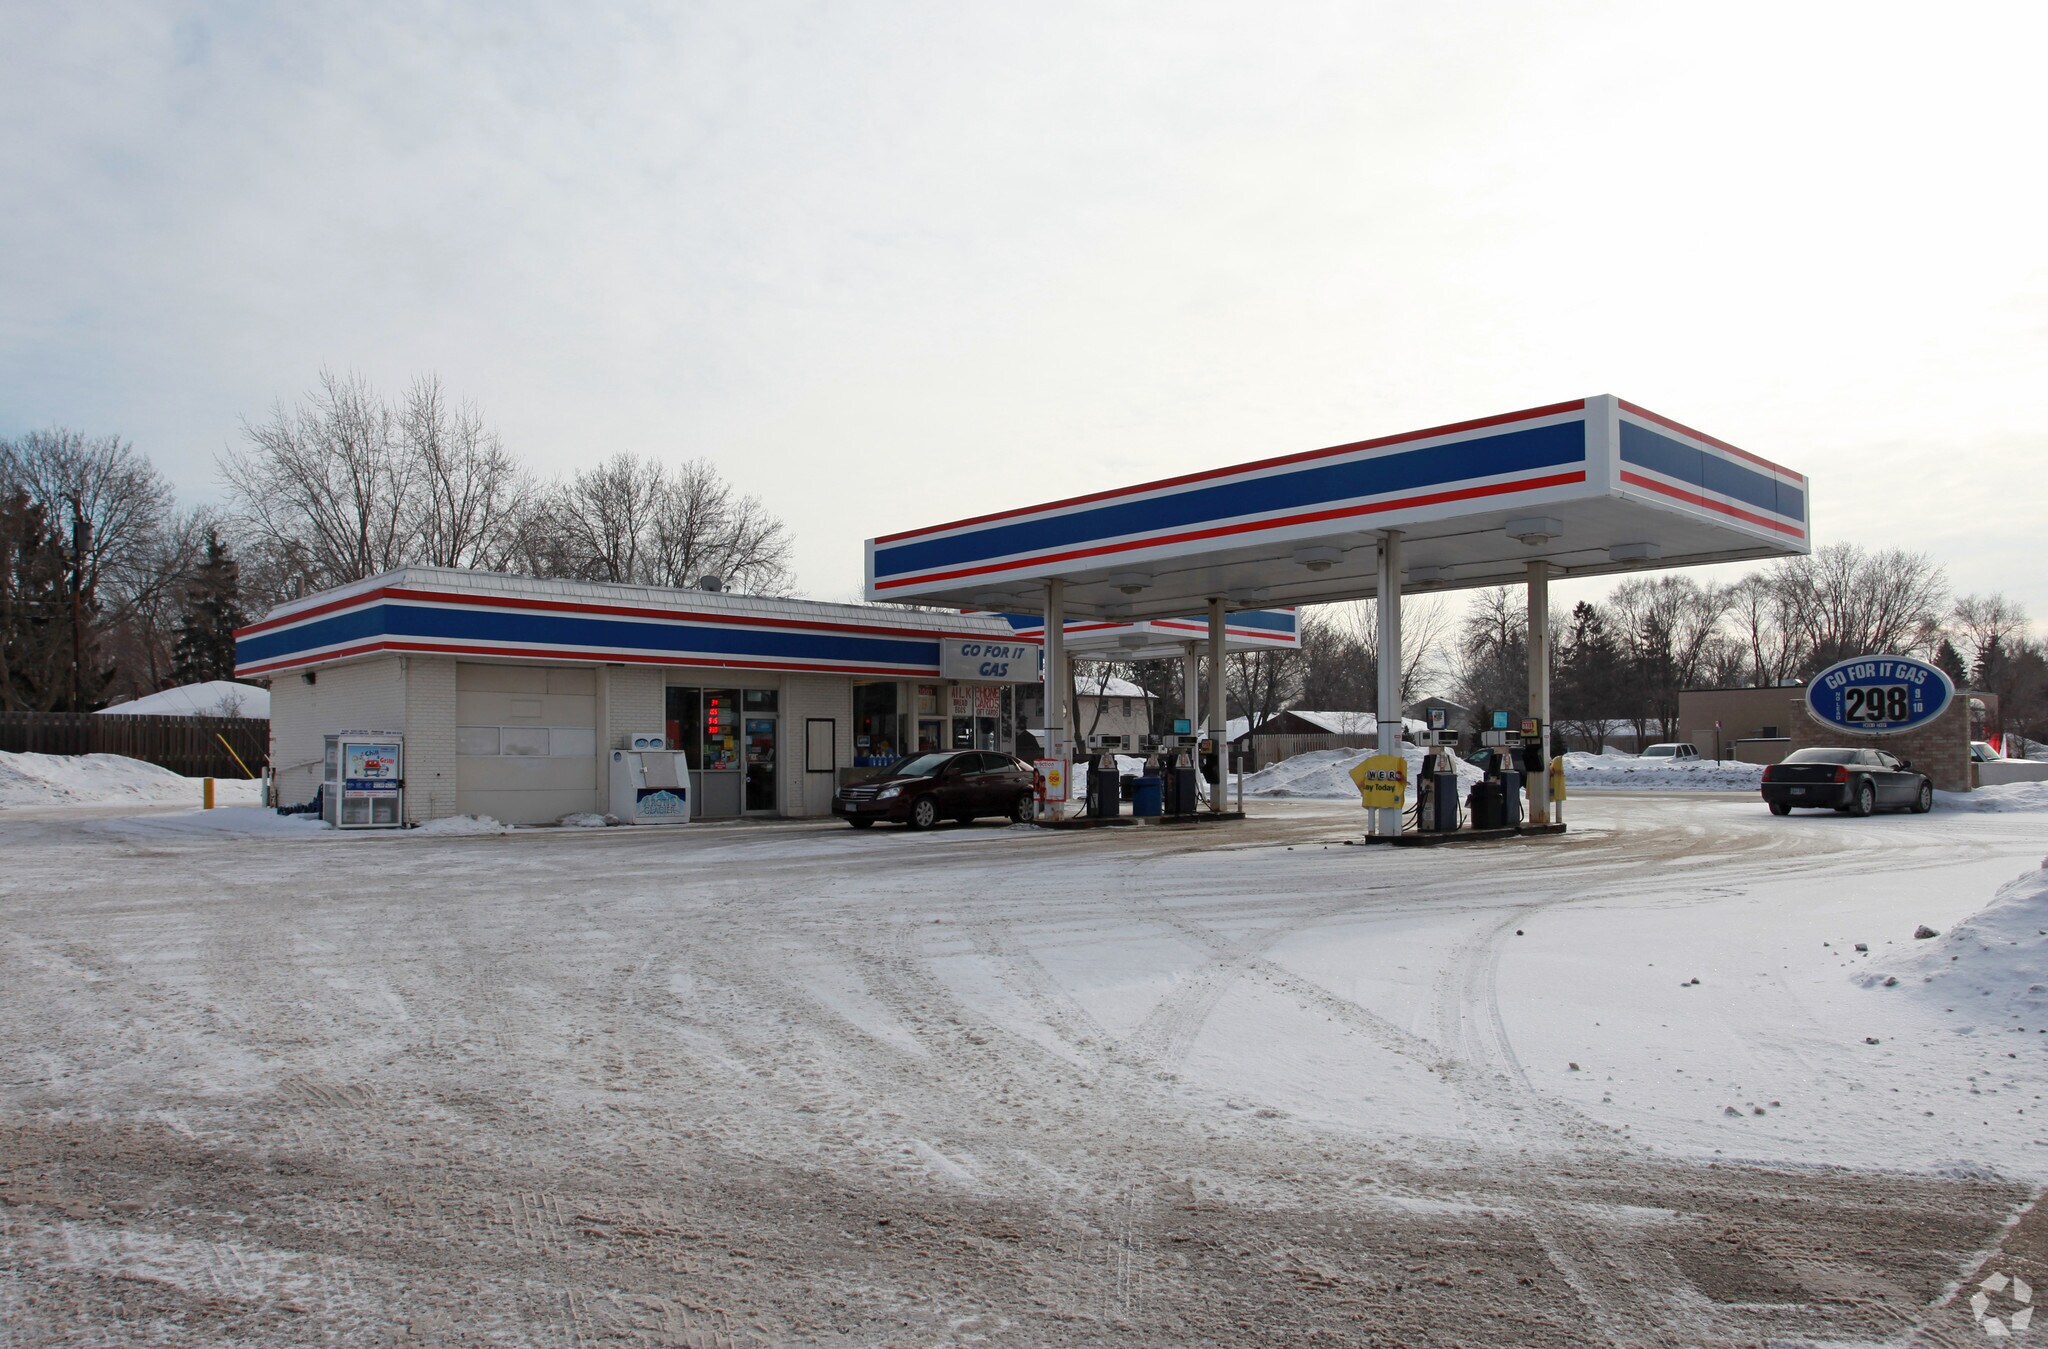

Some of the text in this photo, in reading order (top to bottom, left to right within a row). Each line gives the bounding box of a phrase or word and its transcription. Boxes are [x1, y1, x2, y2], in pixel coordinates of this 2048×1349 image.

[961, 644, 1026, 660] GO FOR IT
[979, 661, 1009, 677] GAS
[1825, 662, 1928, 690] GO FOR IT GAS
[975, 686, 1000, 699] PHONE
[1915, 688, 1921, 699] 9
[975, 698, 1000, 709] CARDS
[1846, 686, 1907, 721] 298
[1913, 702, 1924, 713] 10
[1367, 771, 1396, 779] WER
[1375, 784, 1395, 793] Today
